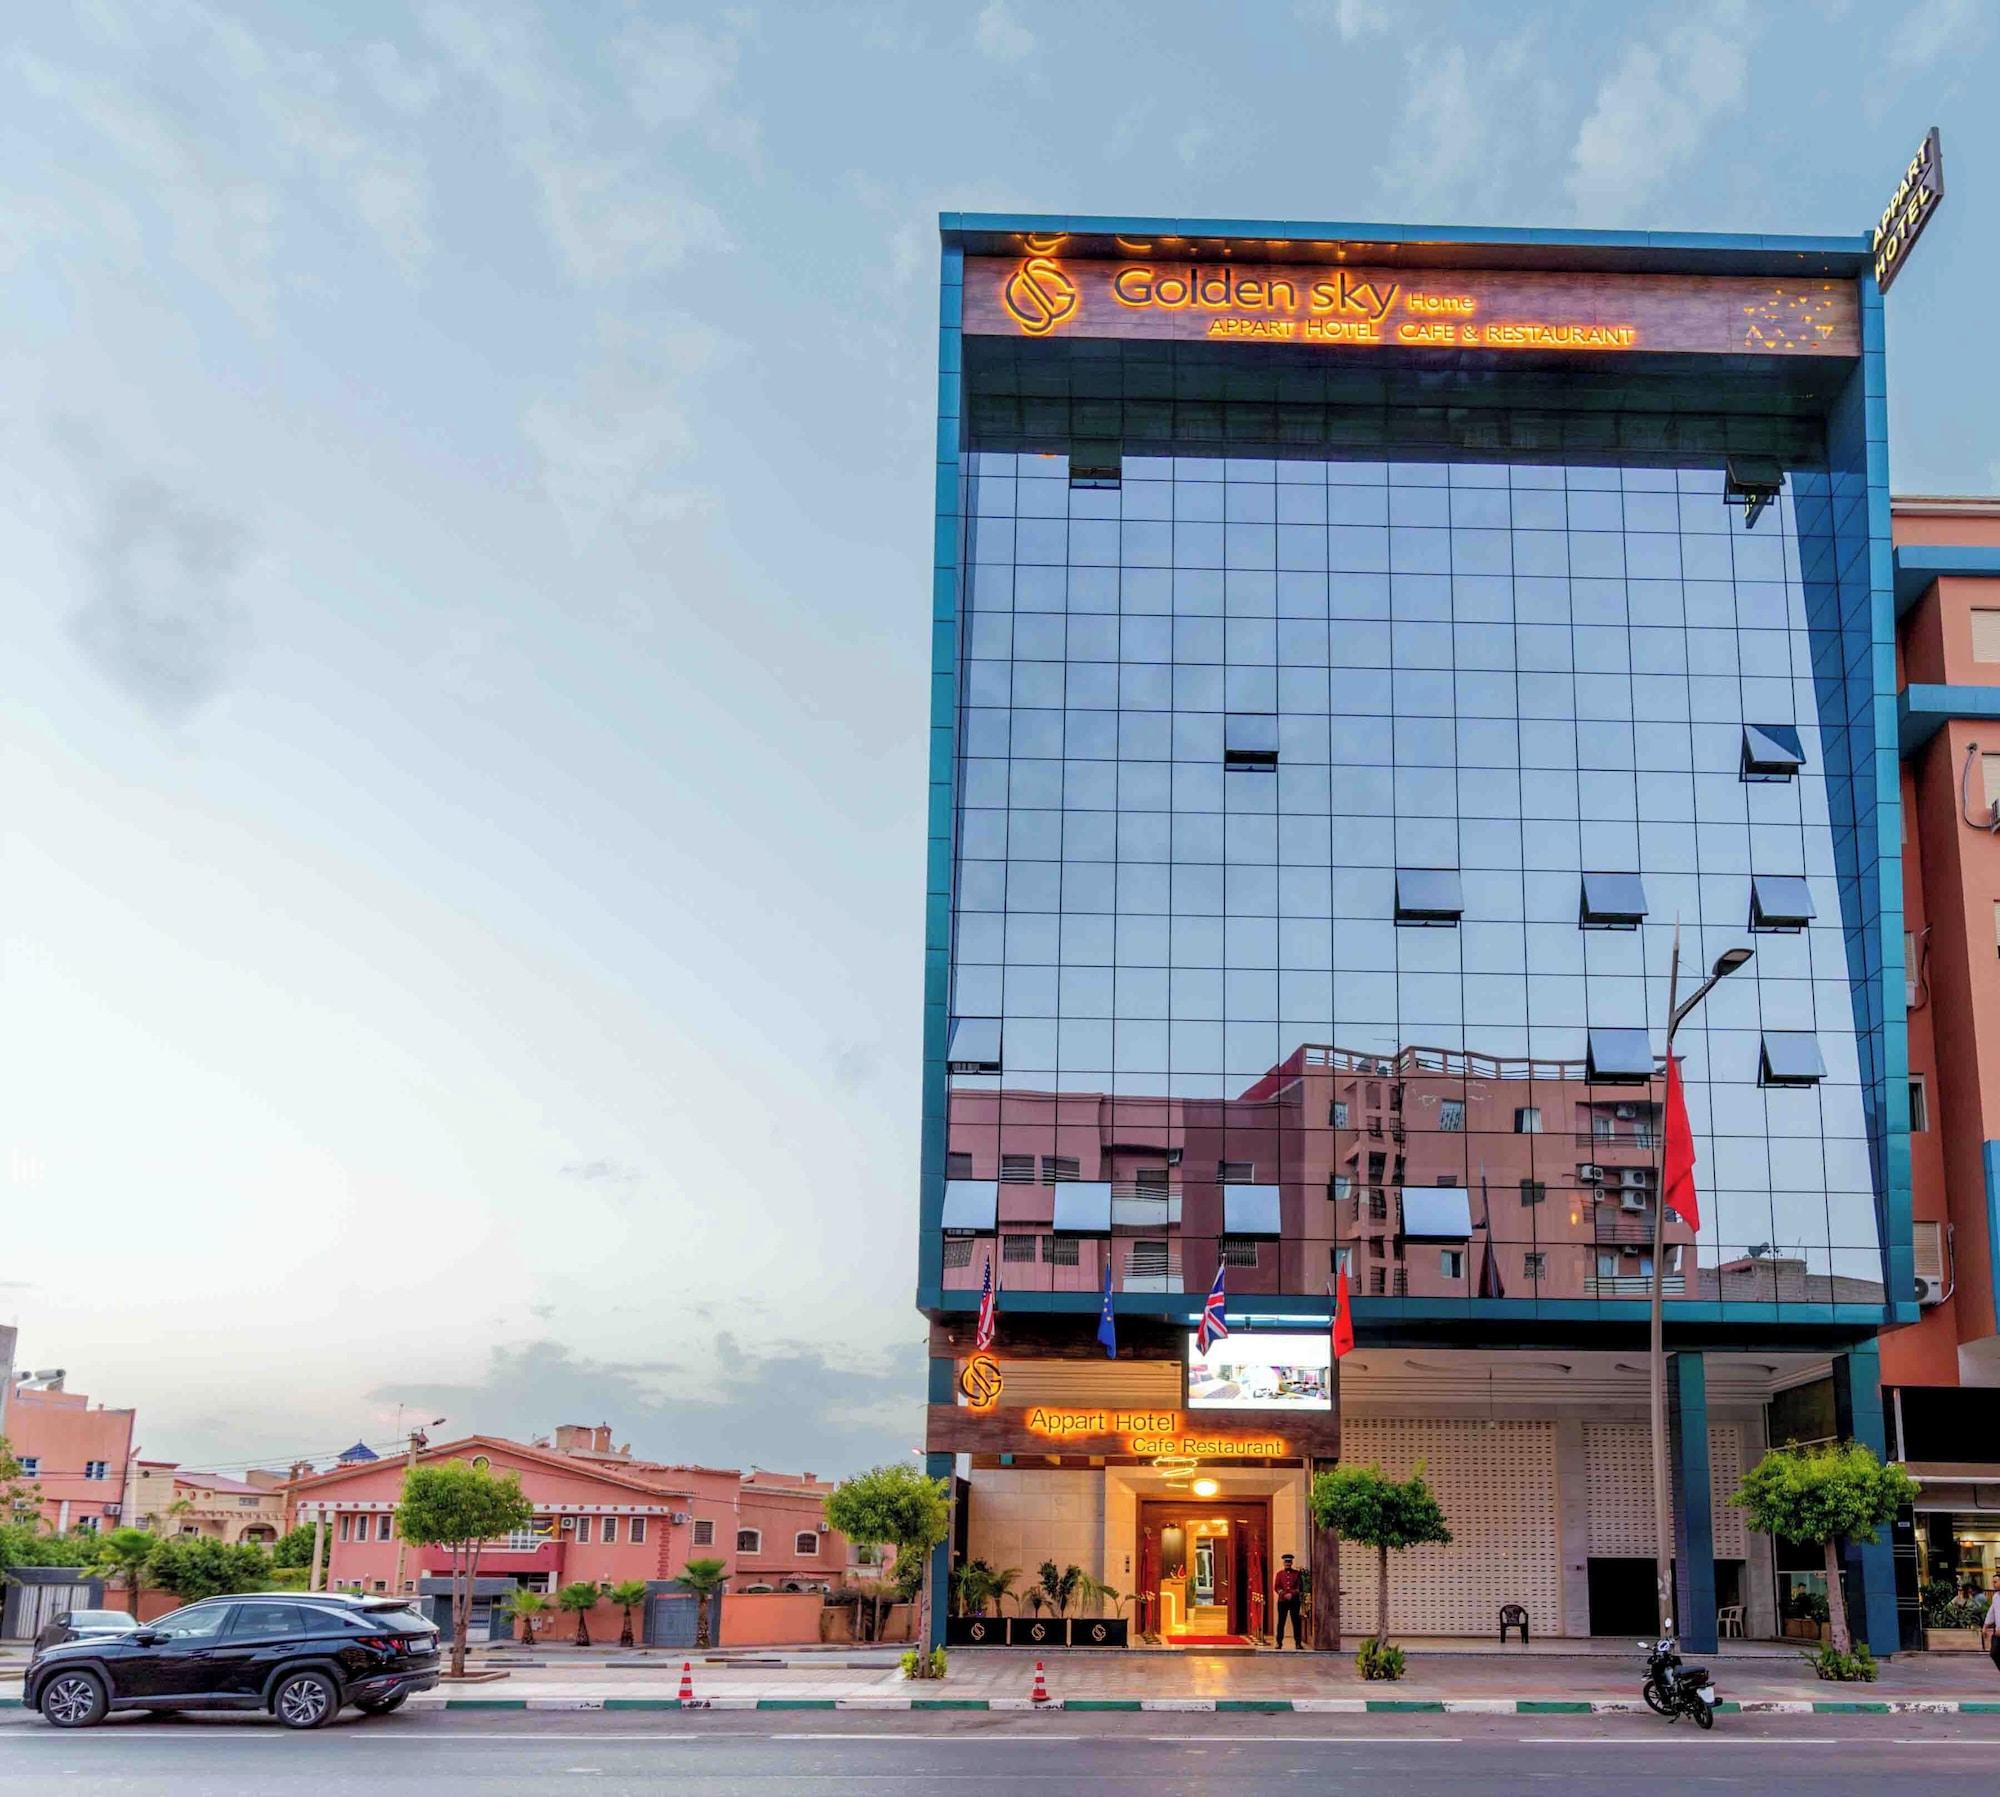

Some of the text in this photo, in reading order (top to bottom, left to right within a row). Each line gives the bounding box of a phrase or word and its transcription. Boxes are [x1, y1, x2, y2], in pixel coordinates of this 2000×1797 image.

[1873, 138, 1931, 251] APPART
[1875, 185, 1930, 282] HOTEL
[1114, 266, 1474, 321] Golden sky Home
[1208, 318, 1636, 346] APPART HOTEL CAFE & RESTAURANT
[1030, 1408, 1176, 1434] Appart Hotel
[1132, 1437, 1281, 1455] Cafe Restaurant
